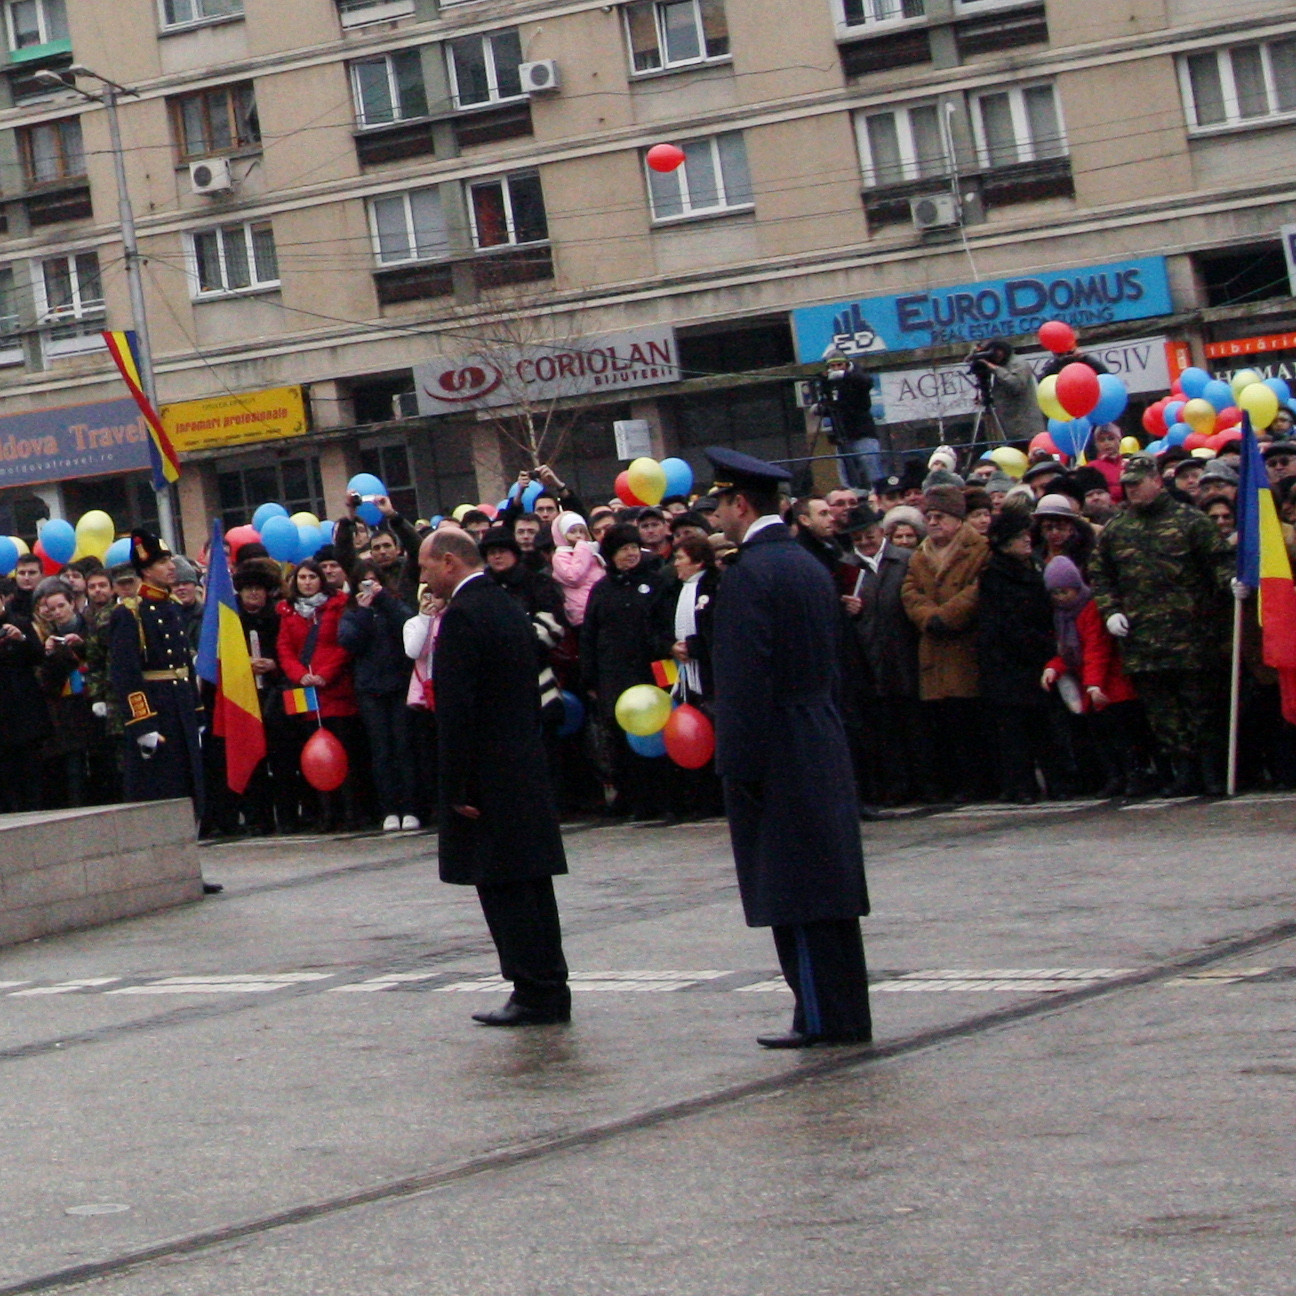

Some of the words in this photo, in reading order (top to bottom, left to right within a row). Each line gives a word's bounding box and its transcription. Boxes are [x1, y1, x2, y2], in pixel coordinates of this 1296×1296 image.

[895, 289, 1001, 332] EURO
[1004, 269, 1144, 316] DOMUS
[968, 319, 1014, 338] ESTATE
[516, 339, 673, 384] CORIOLAN
[594, 367, 673, 386] BIJUTERII
[68, 415, 148, 452] Travel
